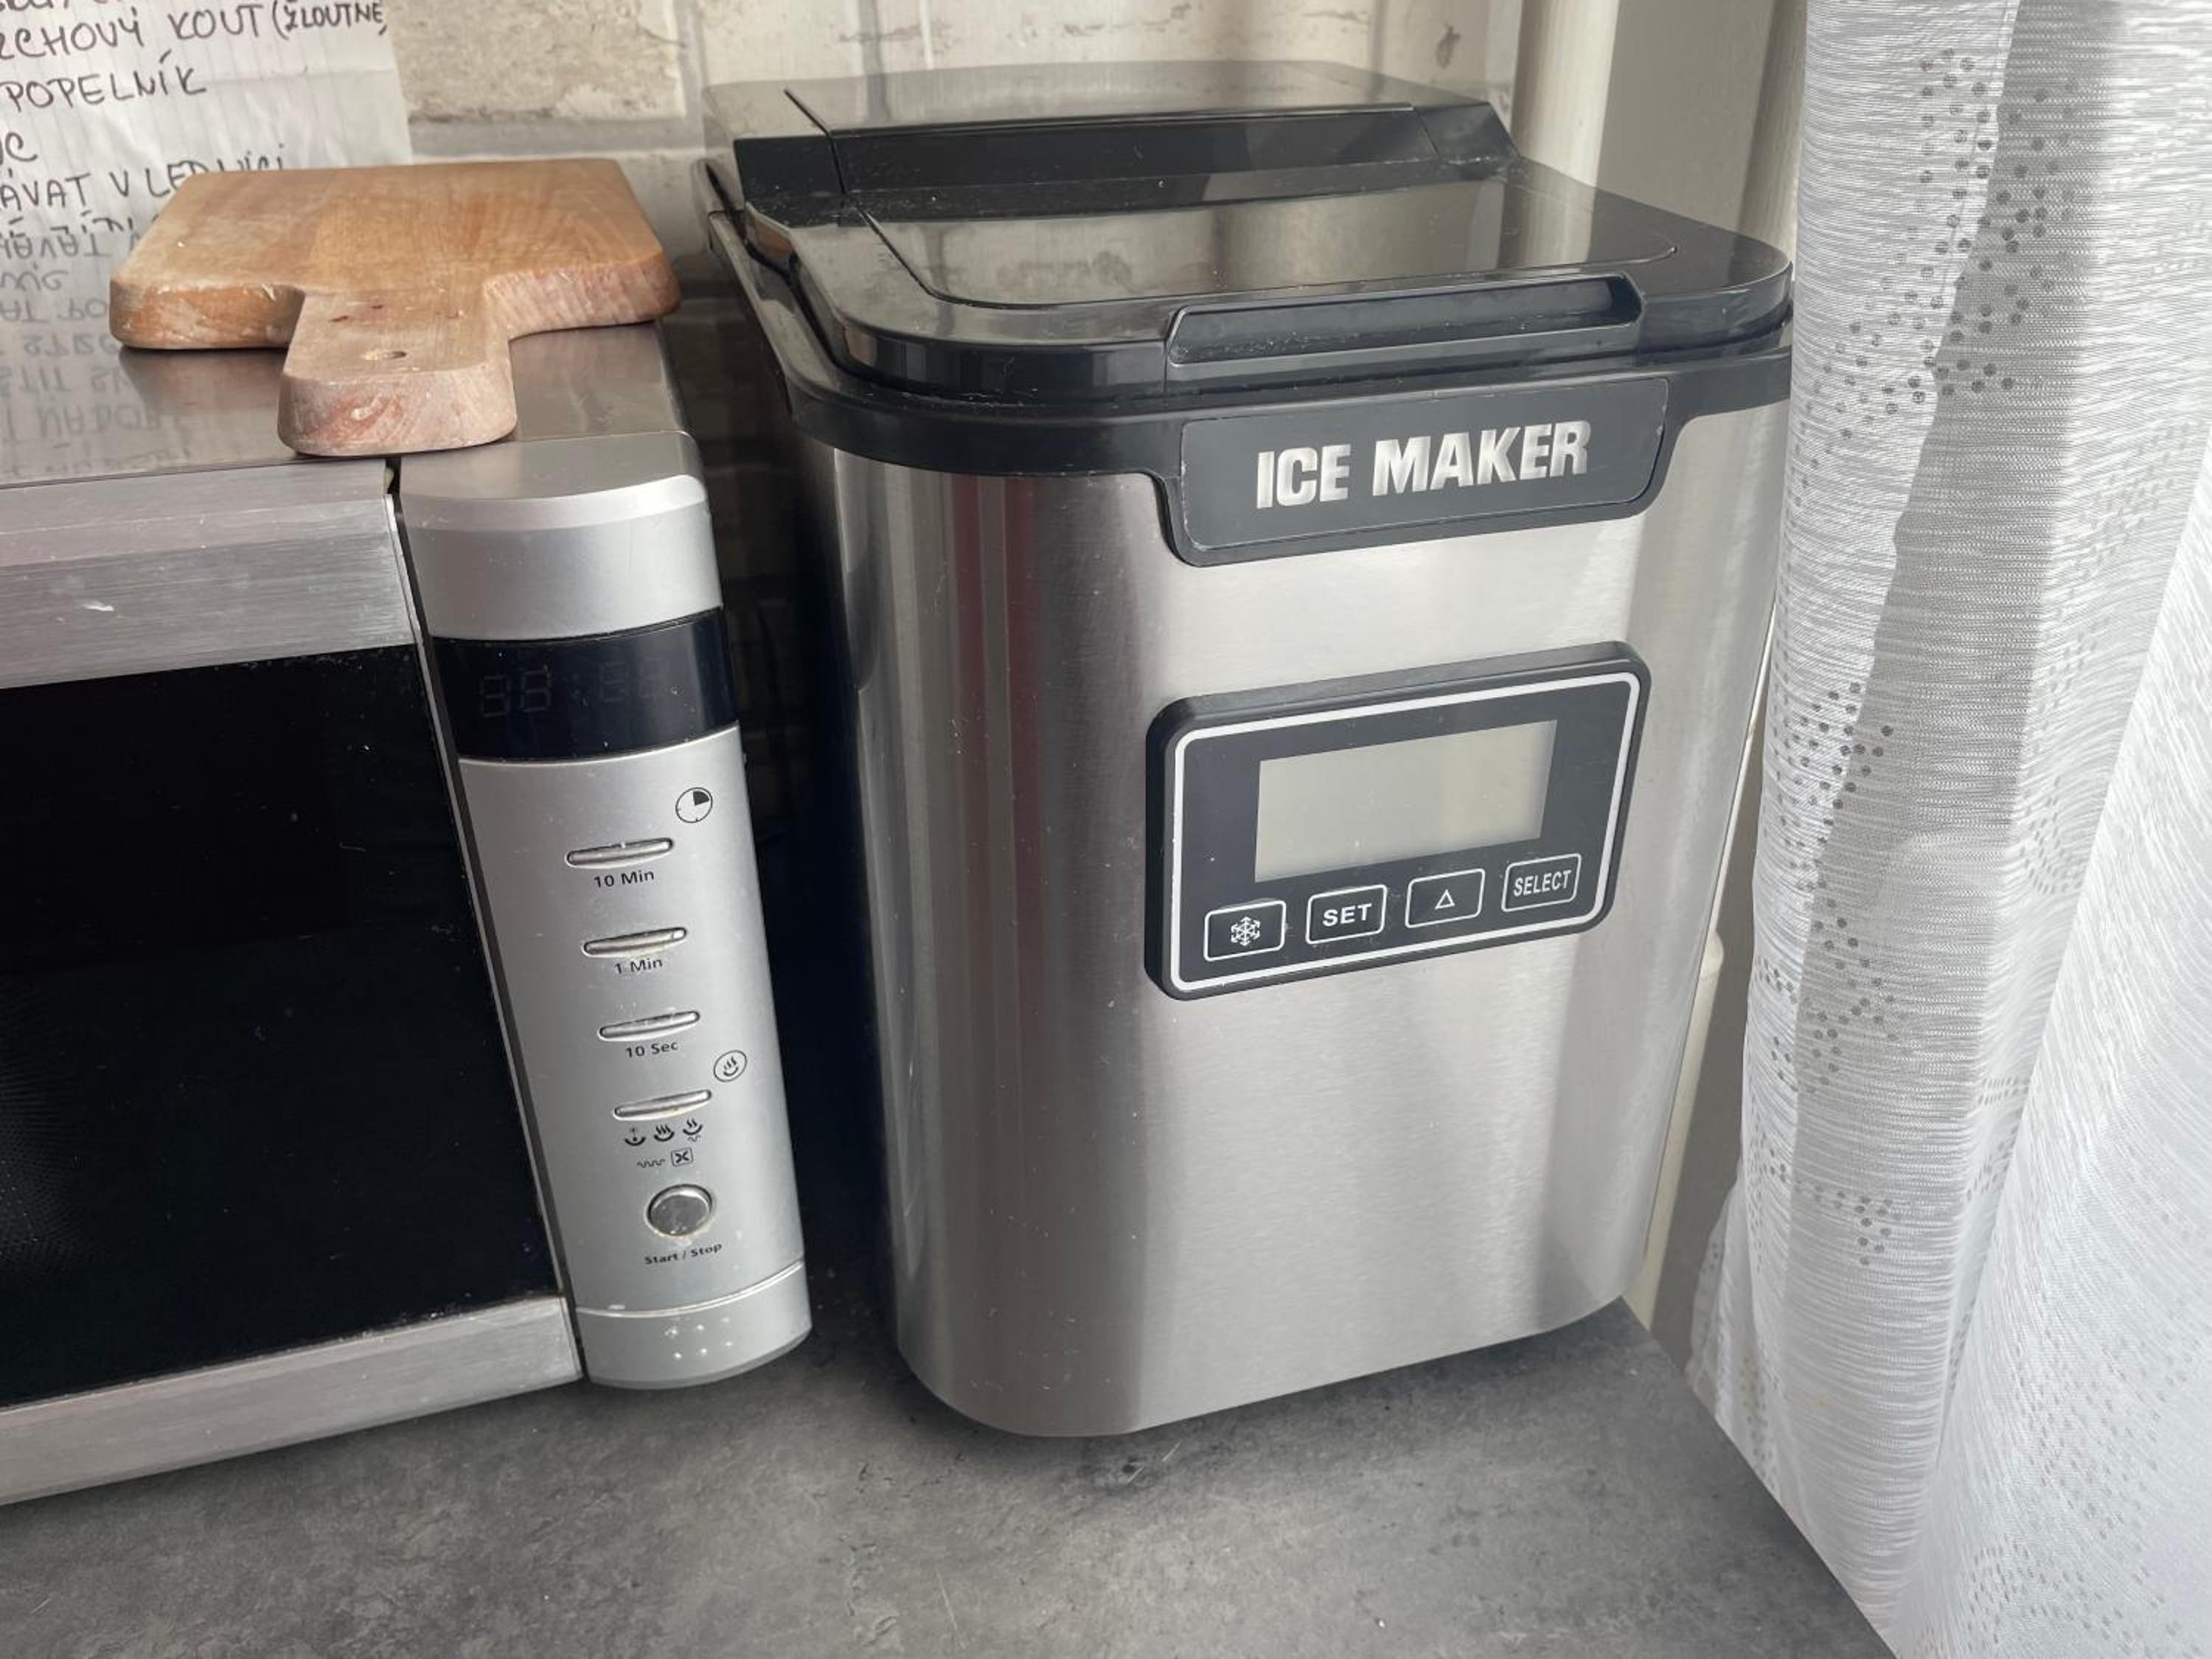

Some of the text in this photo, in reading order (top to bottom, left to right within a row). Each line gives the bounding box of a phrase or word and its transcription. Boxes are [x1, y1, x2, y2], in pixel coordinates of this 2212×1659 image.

[167, 5, 263, 40] KOUT
[0, 49, 206, 112] POPELNÍK
[0, 167, 92, 211] ÁVAT
[108, 170, 129, 198] V
[1256, 420, 1591, 509] ICE MAKER
[594, 869, 655, 888] 10 Min
[1513, 869, 1572, 897] SELECT
[1322, 902, 1372, 927] SET
[614, 958, 663, 974] 1 Min
[625, 1041, 678, 1058] 10 Sec
[644, 1253, 678, 1265] Start
[690, 1243, 723, 1257] Stop
